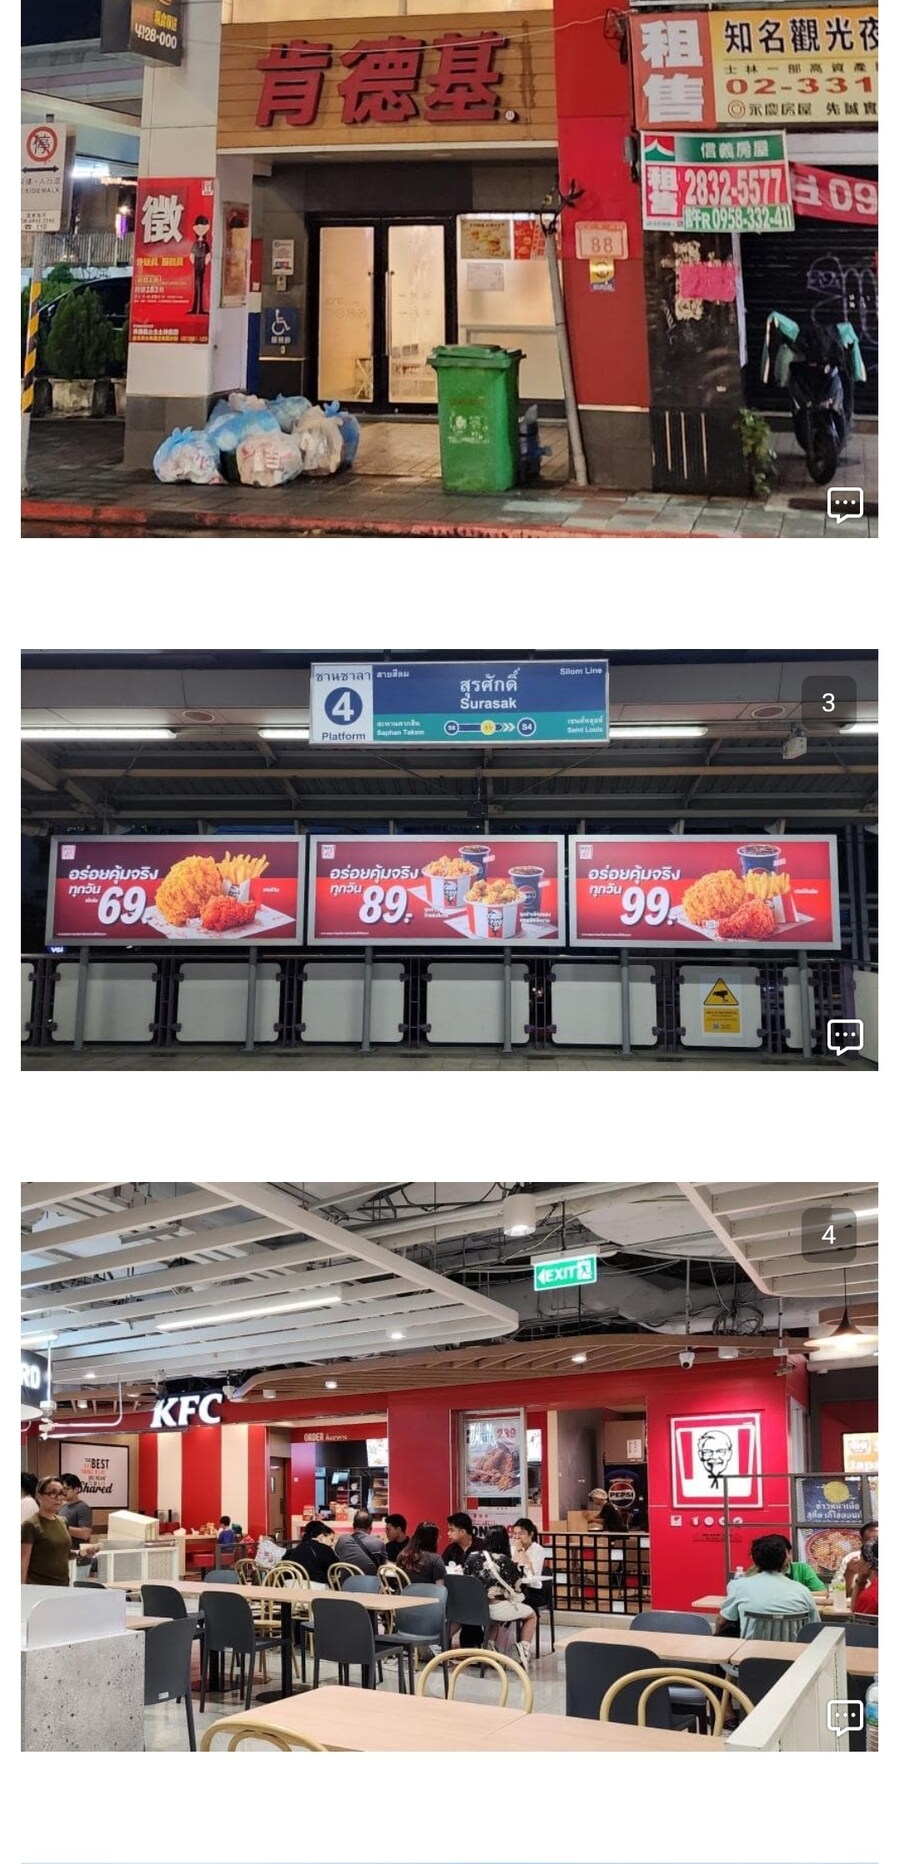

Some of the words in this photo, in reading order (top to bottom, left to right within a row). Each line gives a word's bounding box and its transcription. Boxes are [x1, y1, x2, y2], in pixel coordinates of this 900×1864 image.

[254, 31, 509, 127] 肯德基
[641, 20, 704, 123] 租售
[725, 76, 873, 95] 02-331
[700, 140, 769, 159] 信義房屋
[685, 168, 783, 205] 2832-5577
[141, 194, 185, 244] 徵
[590, 237, 614, 253] 88
[315, 668, 371, 682] ชานชาลา
[560, 667, 583, 676] Silom
[585, 666, 603, 675] Line
[460, 667, 520, 698] สุรศักดิ์
[331, 691, 355, 721] 4
[460, 697, 517, 710] Surasak
[322, 731, 366, 741] Platform
[521, 722, 533, 732] S4
[69, 865, 159, 884] อร่อยคุ้มจริง
[330, 865, 418, 884] อร่อยคุ้มจริง
[588, 865, 680, 884] อร่อยคุ้มจริง
[68, 882, 102, 897] ทุกวัน
[330, 882, 363, 897] ทุกวัน
[589, 882, 622, 897] ทุกวัน
[544, 1265, 577, 1283] EXIT
[150, 1393, 223, 1428] KFC
[304, 1432, 325, 1442] ORDER
[91, 1458, 110, 1470] BEST
